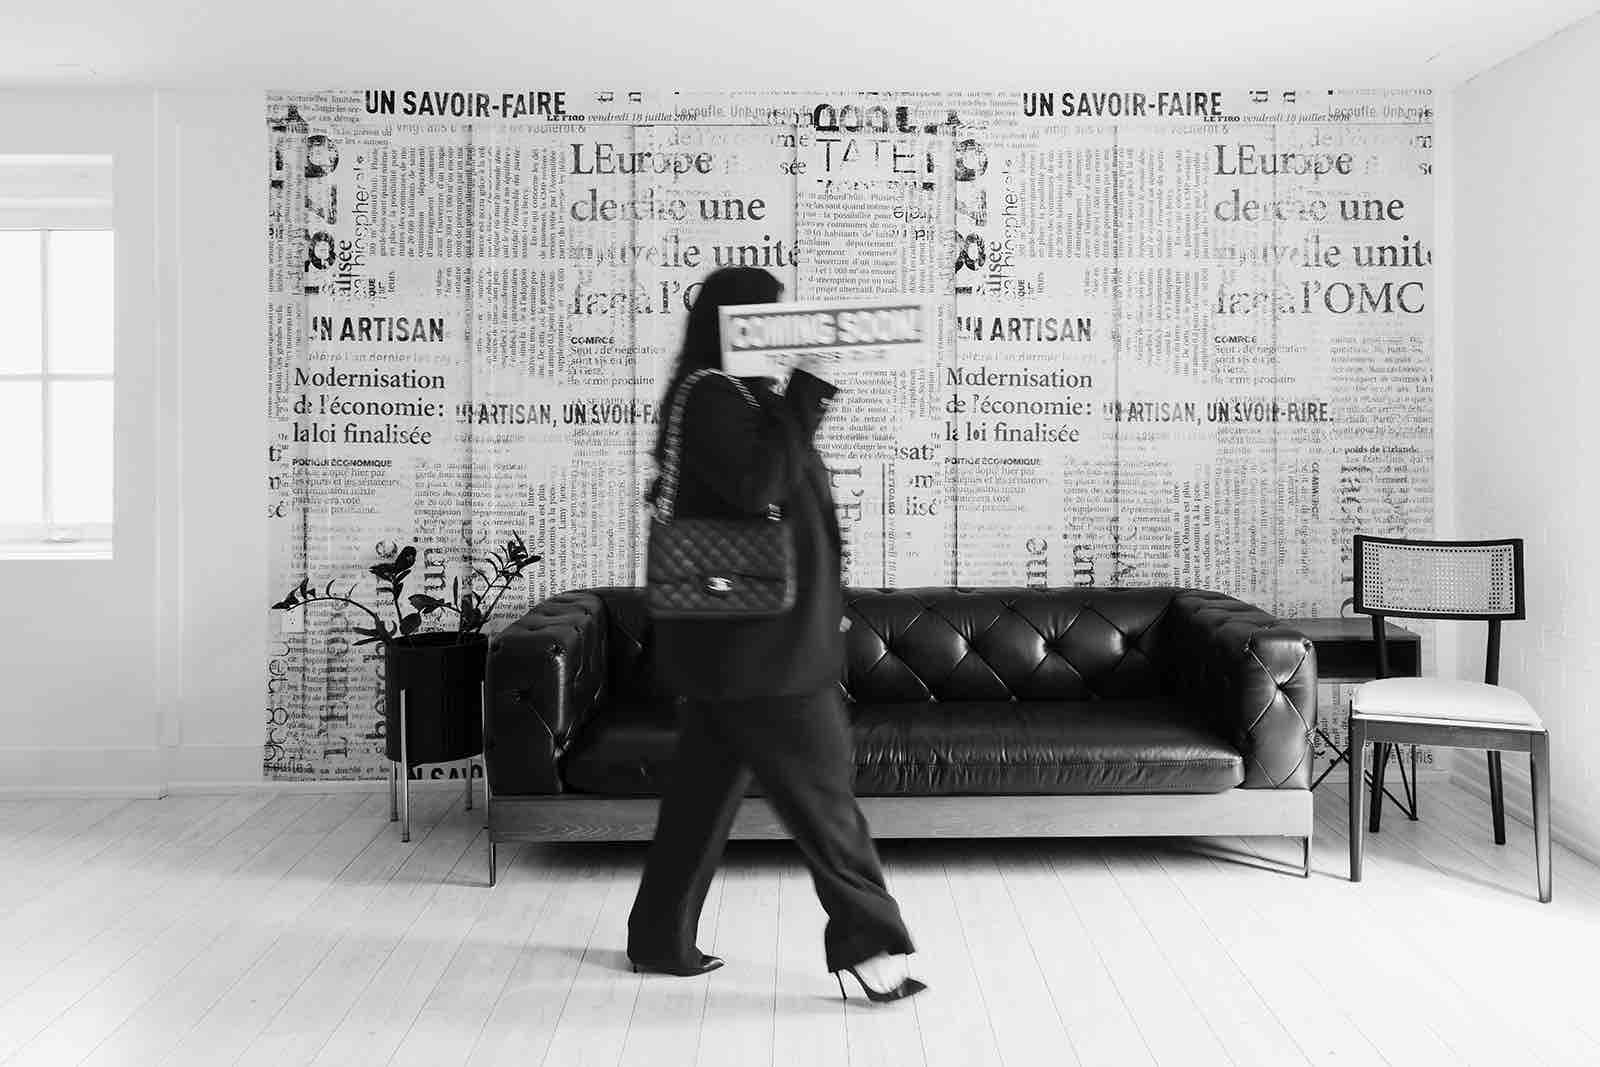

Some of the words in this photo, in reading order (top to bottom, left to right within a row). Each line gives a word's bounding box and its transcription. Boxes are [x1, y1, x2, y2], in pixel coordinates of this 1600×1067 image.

[366, 91, 396, 114] UN
[403, 91, 566, 118] SAVOIR-FAIRE
[1024, 93, 1054, 116] UN
[1062, 93, 1222, 116] SAVOIR-FAIRE
[699, 198, 766, 220] une
[1339, 199, 1404, 221] une
[713, 235, 801, 266] unité
[1301, 280, 1425, 314] l'OMC
[340, 317, 444, 342] ARTISAN
[990, 317, 1091, 341] ARTISAN
[294, 367, 445, 389] Modernisation
[946, 367, 1092, 388] Modernisation
[946, 394, 966, 413] de
[1127, 402, 1201, 426] ARTISAN,
[1208, 402, 1229, 422] UN
[478, 404, 557, 428] ARTISAN,
[563, 404, 586, 424] UN
[344, 423, 432, 444] finalisée
[994, 422, 1080, 442] finalisée
